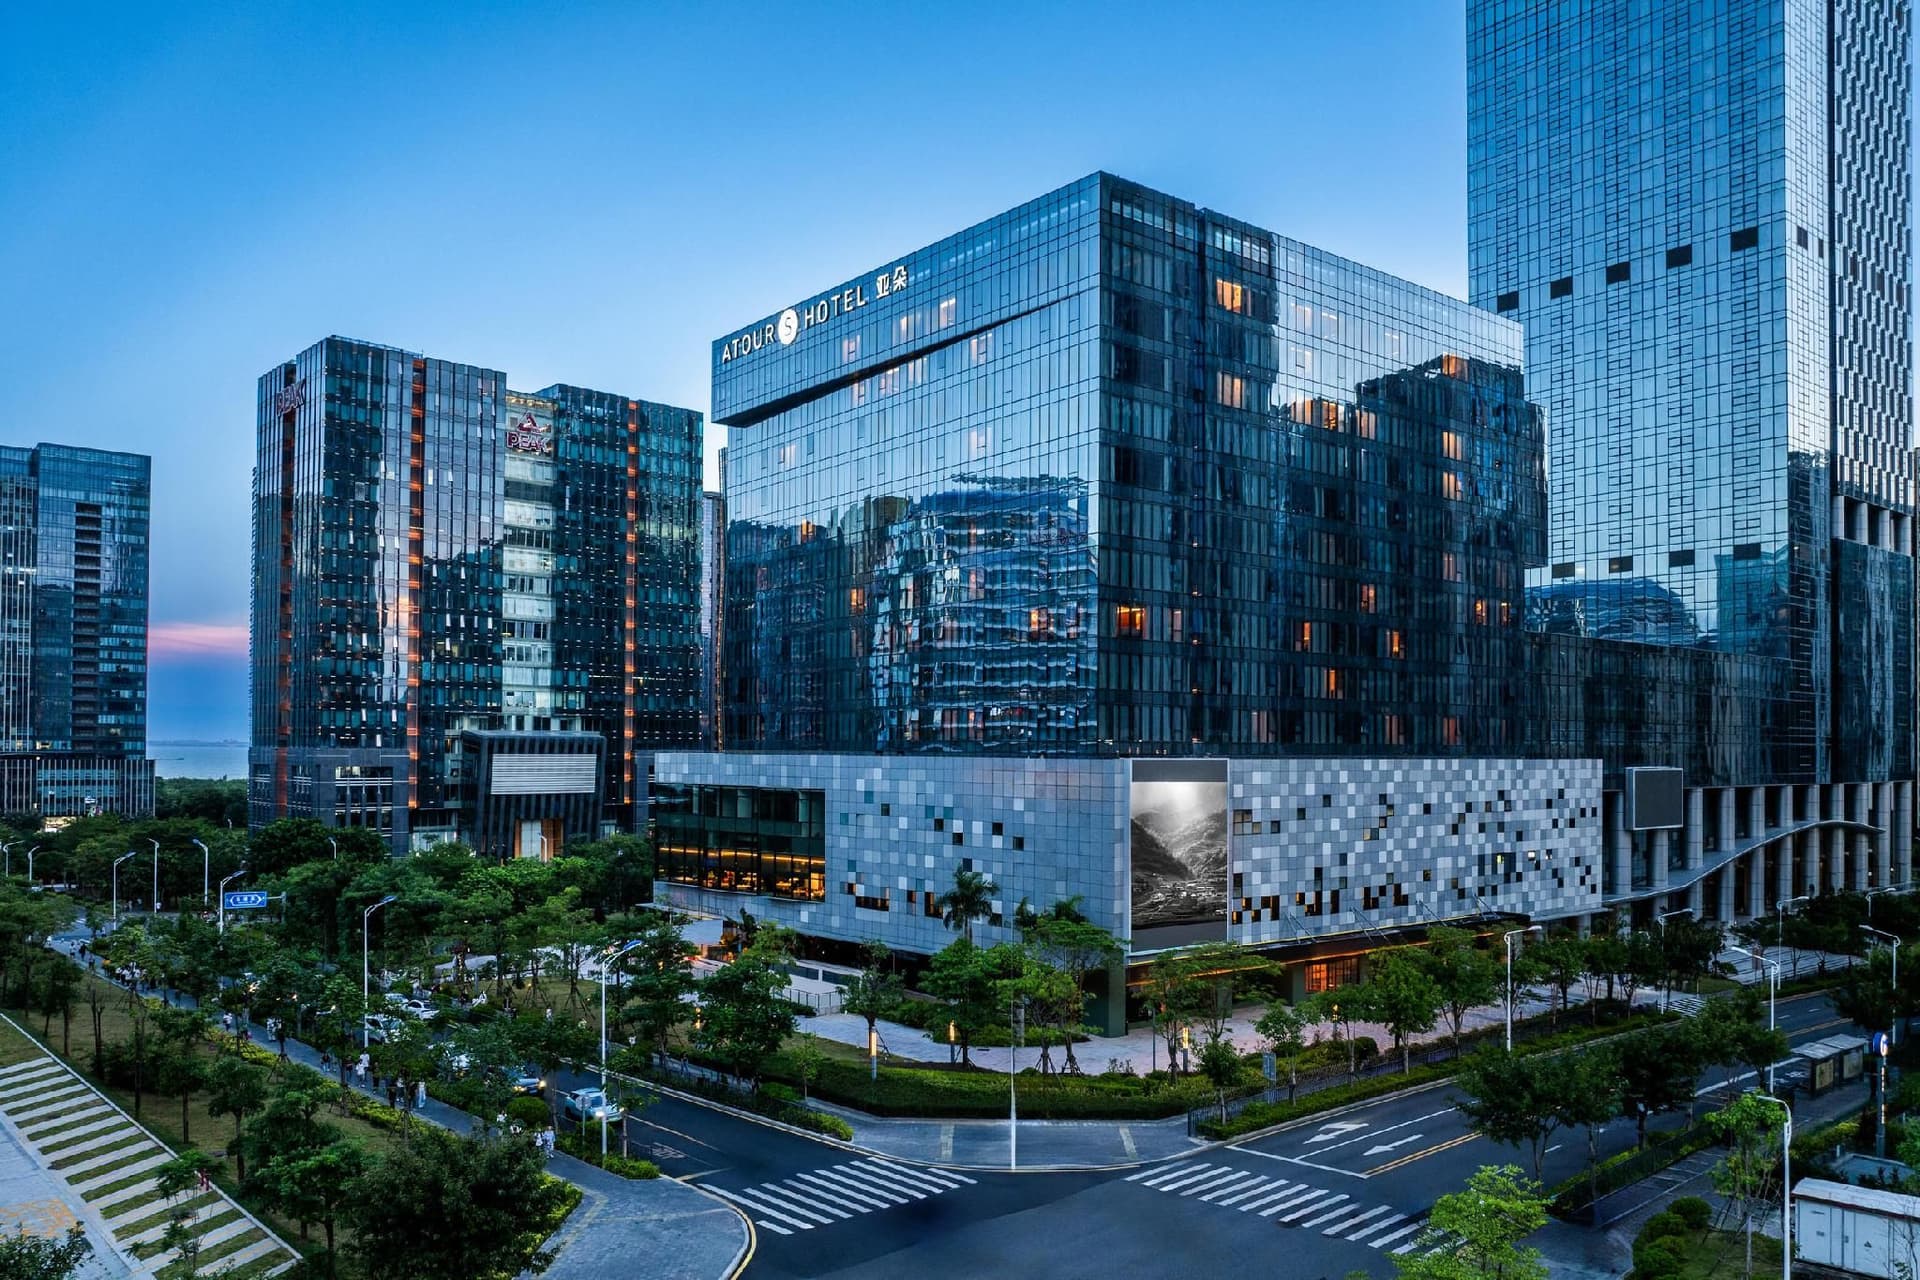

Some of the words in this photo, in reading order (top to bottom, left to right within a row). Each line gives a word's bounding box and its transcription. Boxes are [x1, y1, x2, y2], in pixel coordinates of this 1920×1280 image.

[721, 324, 775, 363] ATOUR
[804, 286, 867, 329] HOTEL
[876, 265, 908, 299] 亚朵
[506, 431, 552, 453] PEAK
